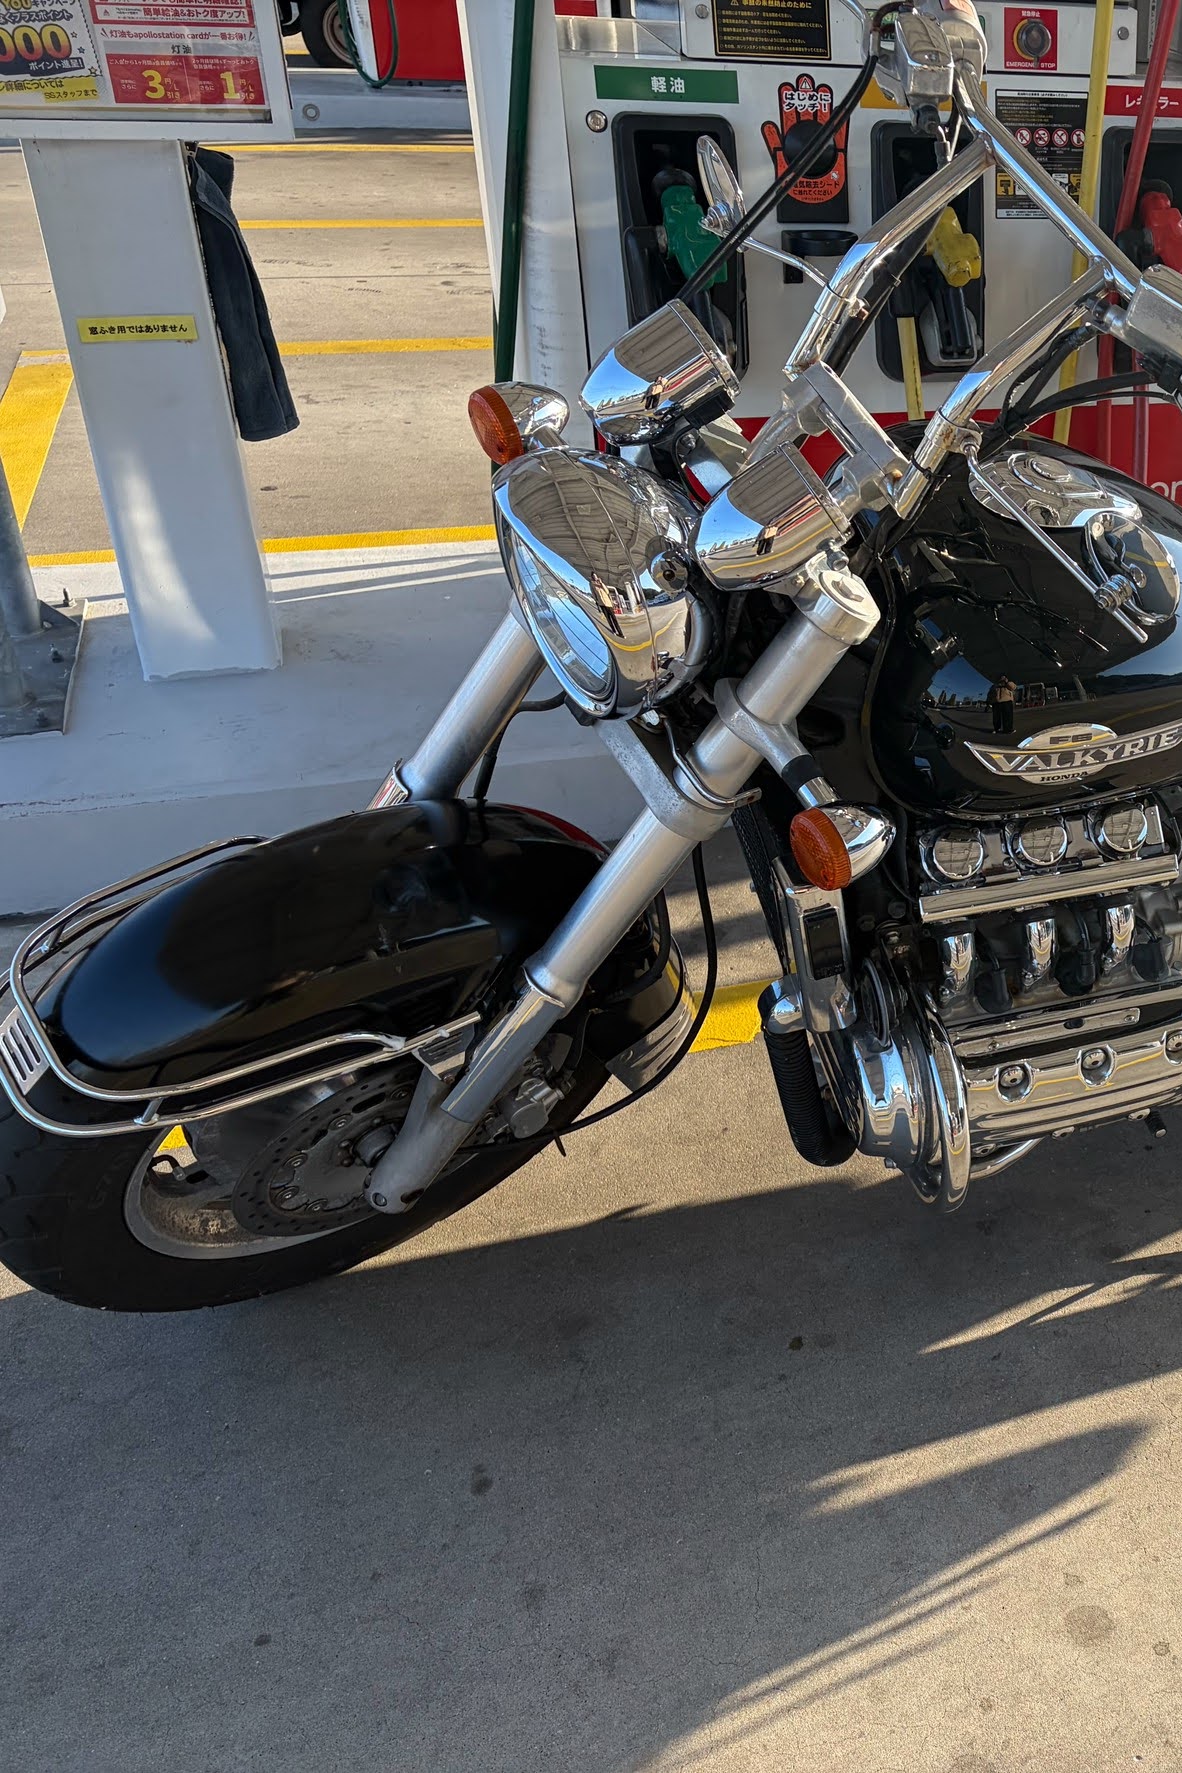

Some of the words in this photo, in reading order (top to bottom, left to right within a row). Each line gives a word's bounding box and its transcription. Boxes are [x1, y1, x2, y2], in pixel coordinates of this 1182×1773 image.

[0, 10, 72, 23] くプラスポイント
[171, 44, 192, 54] 灯油
[142, 69, 165, 99] 3
[220, 71, 241, 99] 1
[651, 76, 685, 93] 軽油
[44, 89, 97, 99] SSスタッフまで
[784, 91, 831, 101] はじめに
[784, 102, 828, 112] タッチ!
[1125, 94, 1179, 110] レラー
[88, 324, 188, 335] 窓ふき用ではありません
[986, 728, 1179, 772] VALKYRIE
[1040, 771, 1089, 782] HONDA
